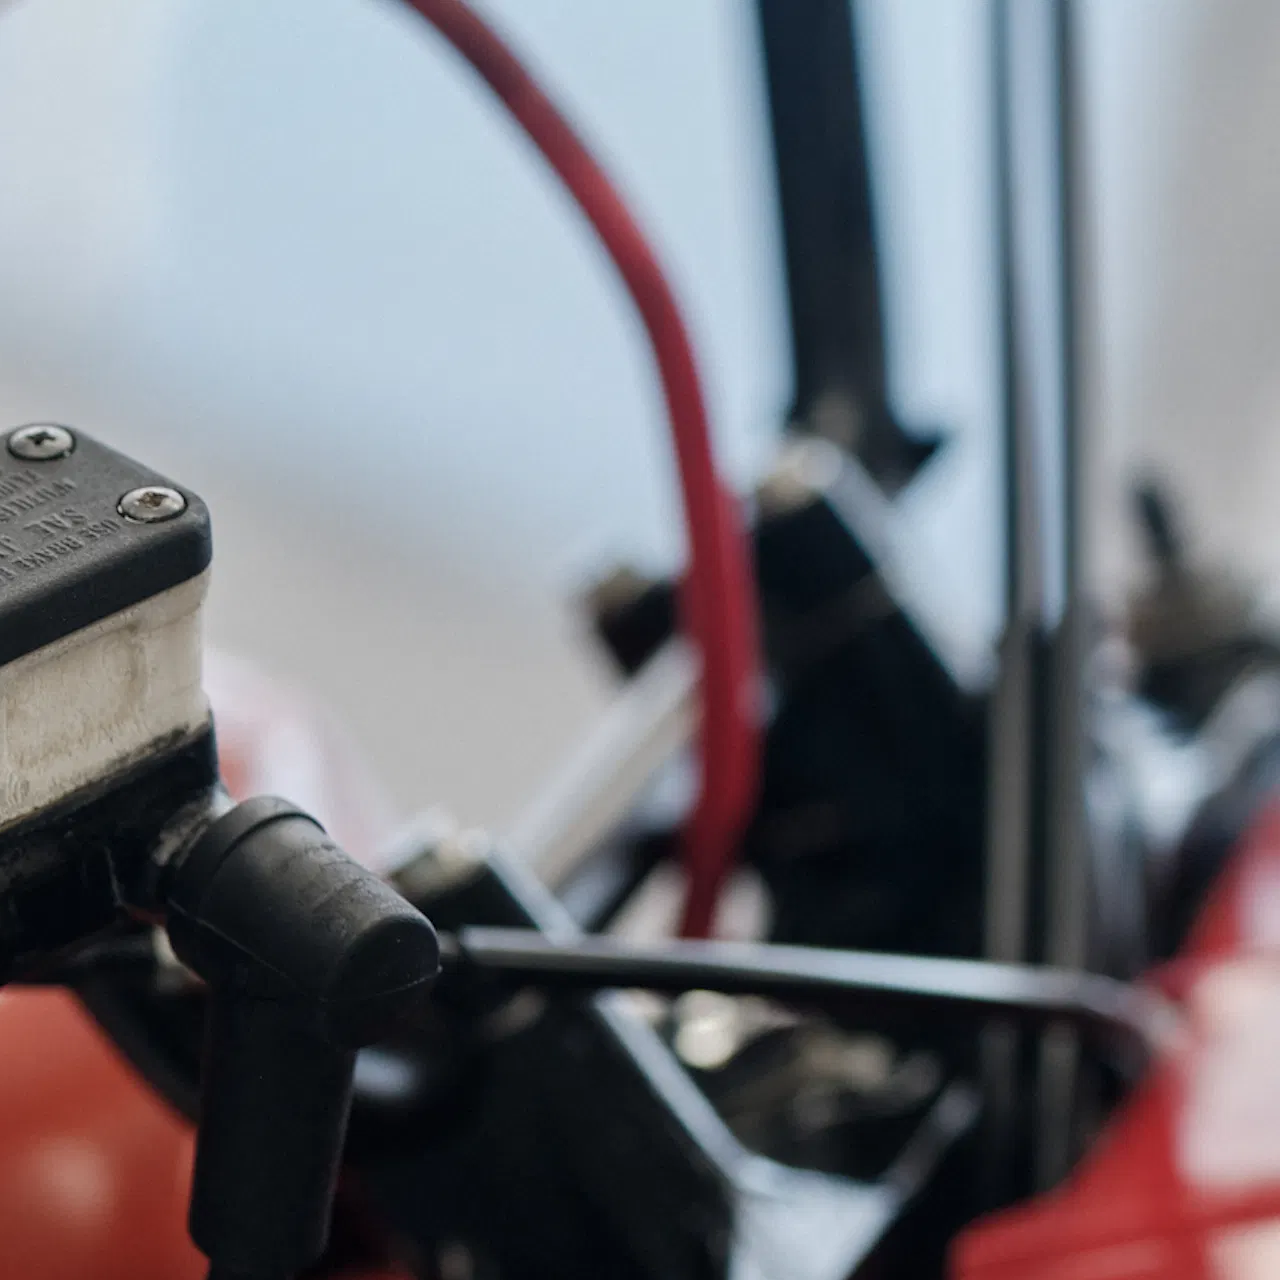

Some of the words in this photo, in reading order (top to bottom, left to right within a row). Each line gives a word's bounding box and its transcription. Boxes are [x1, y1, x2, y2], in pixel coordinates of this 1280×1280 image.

[22, 506, 89, 541] SAE
[77, 518, 123, 541] USE
[12, 535, 84, 571] BRAKE
